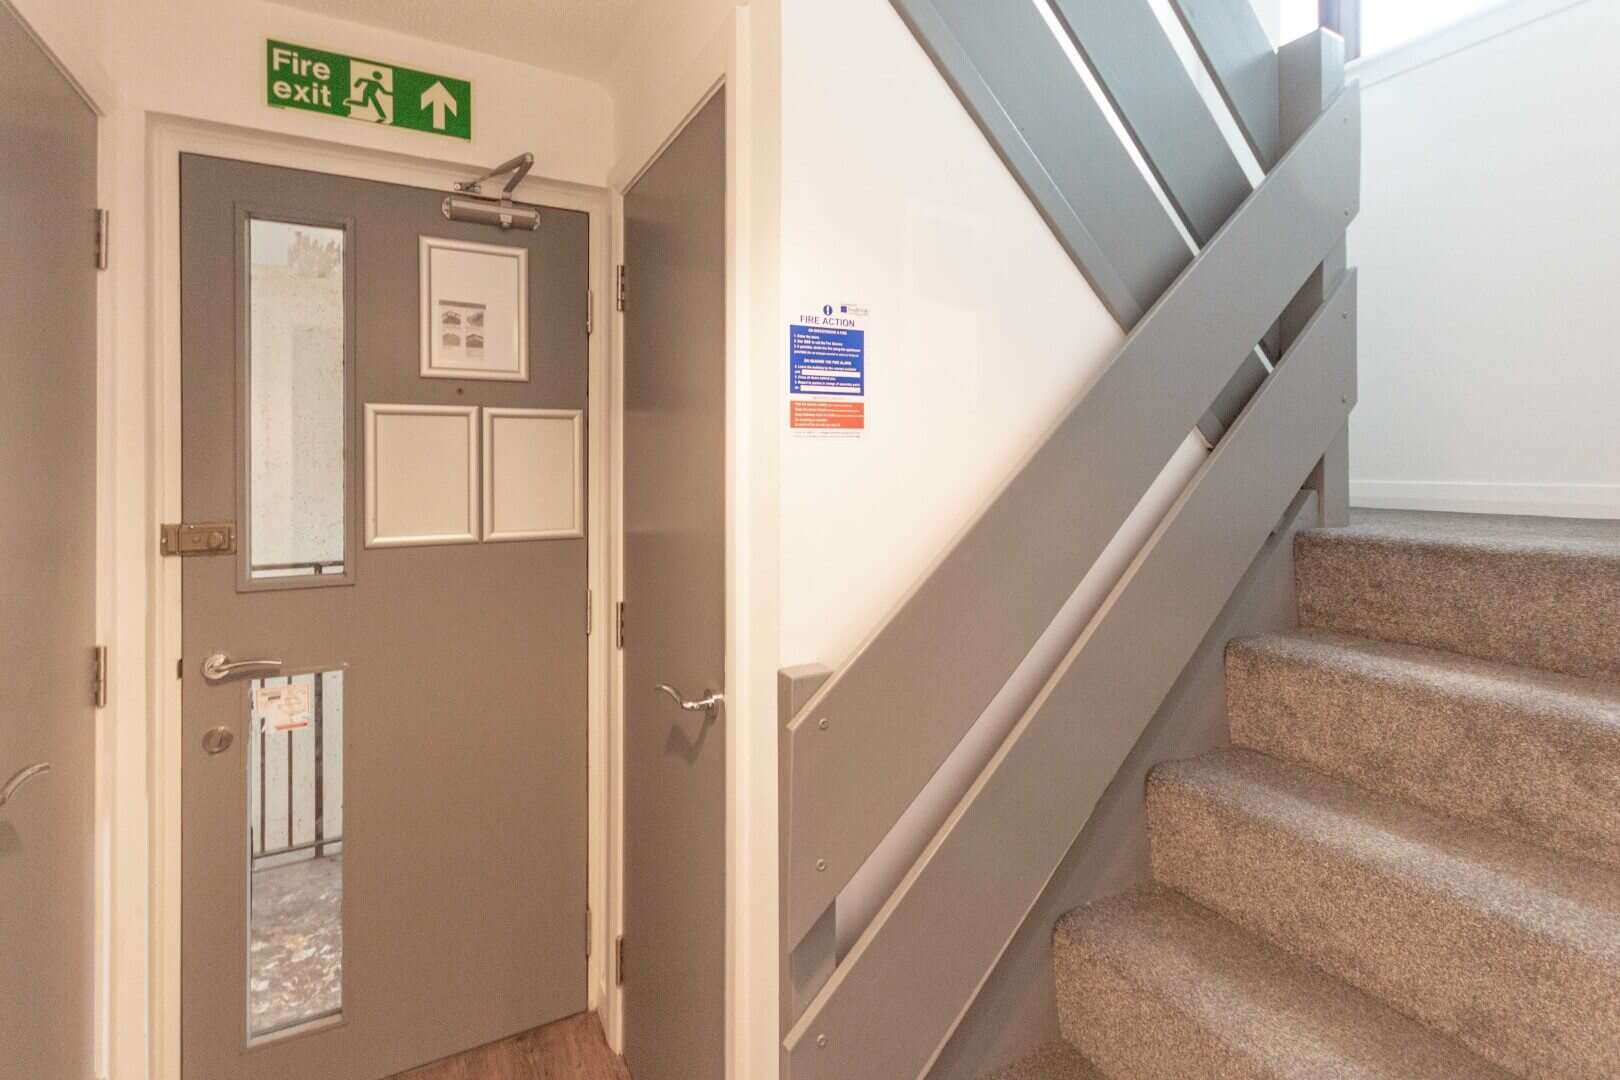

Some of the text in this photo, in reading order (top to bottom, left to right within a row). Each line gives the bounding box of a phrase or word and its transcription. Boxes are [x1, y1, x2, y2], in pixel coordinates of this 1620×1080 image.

[273, 48, 331, 80] Fire
[273, 81, 331, 107] exit
[800, 315, 855, 327] FIRE ACTION
